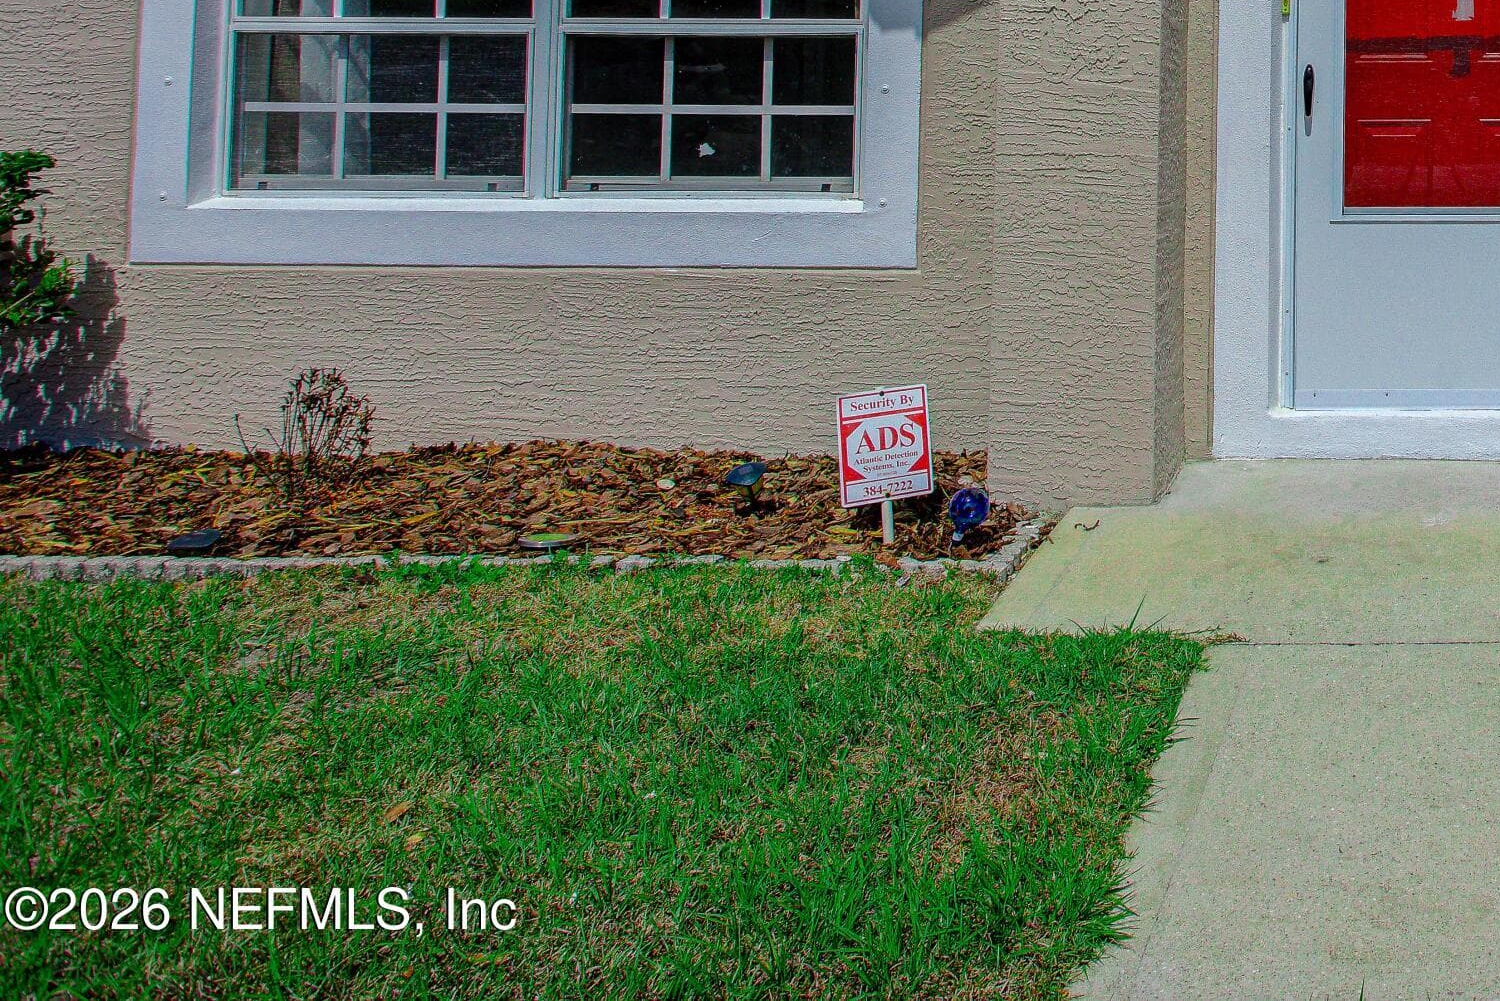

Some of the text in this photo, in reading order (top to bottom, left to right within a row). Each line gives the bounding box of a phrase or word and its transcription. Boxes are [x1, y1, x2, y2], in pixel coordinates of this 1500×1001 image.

[850, 395, 914, 412] Security By
[855, 423, 916, 454] ADS
[854, 450, 918, 465] Atlantic Detection
[863, 463, 894, 473] Systems,
[863, 480, 913, 497] 384-7222
